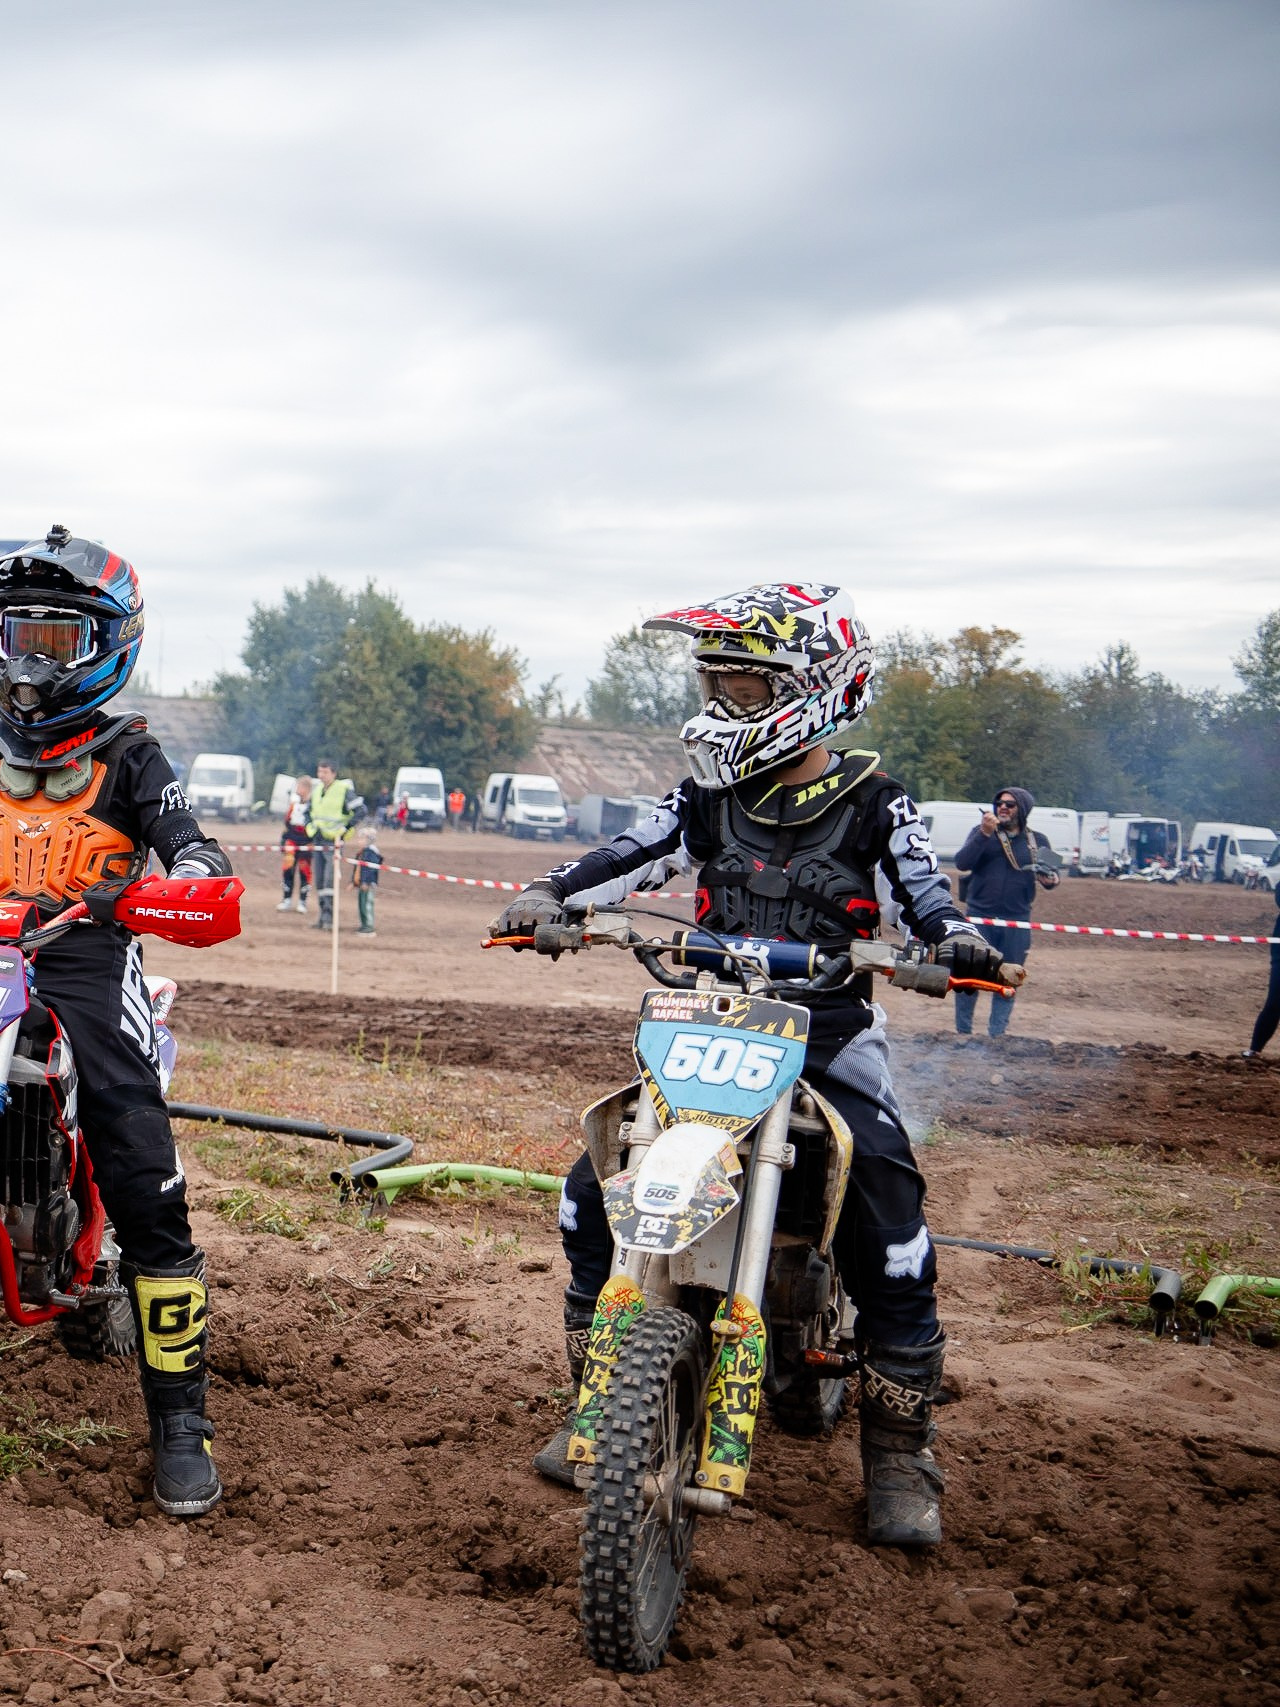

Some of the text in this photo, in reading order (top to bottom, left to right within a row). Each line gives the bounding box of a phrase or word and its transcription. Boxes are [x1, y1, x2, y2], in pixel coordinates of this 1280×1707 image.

[40, 726, 98, 761] LEATT
[135, 906, 213, 921] RACETECH
[651, 1008, 693, 1021] RAFAEL
[660, 1031, 788, 1093] 505
[644, 1187, 680, 1200] 505
